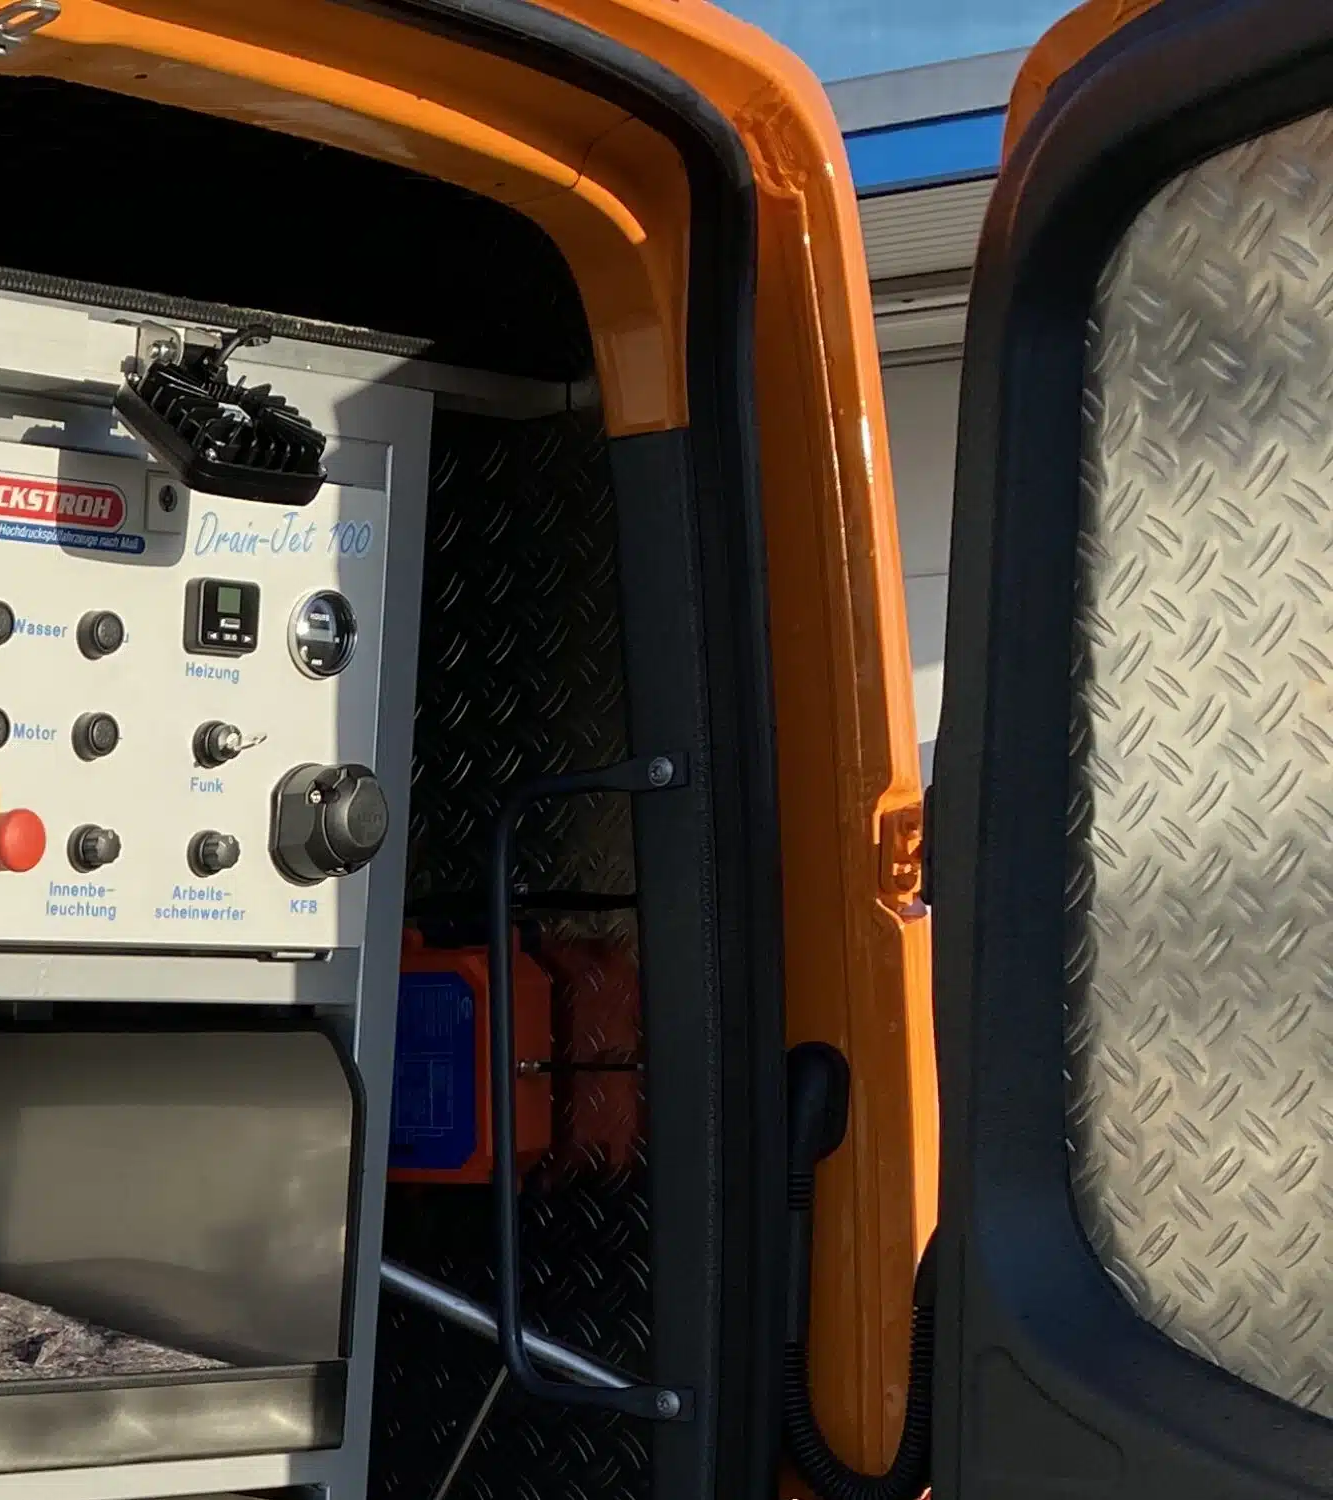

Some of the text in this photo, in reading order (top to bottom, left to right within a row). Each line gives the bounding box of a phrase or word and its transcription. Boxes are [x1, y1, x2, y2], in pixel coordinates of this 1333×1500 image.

[194, 511, 373, 556] Drain-Jet 100
[185, 662, 240, 684] Heizung
[13, 722, 57, 741] Motor
[189, 777, 224, 793] Funk
[49, 880, 116, 898] Innenbe-
[171, 885, 231, 901] Arbeits-
[45, 901, 117, 921] leuchtung
[154, 905, 246, 922] scheinwerfer
[289, 899, 318, 914] KFB
